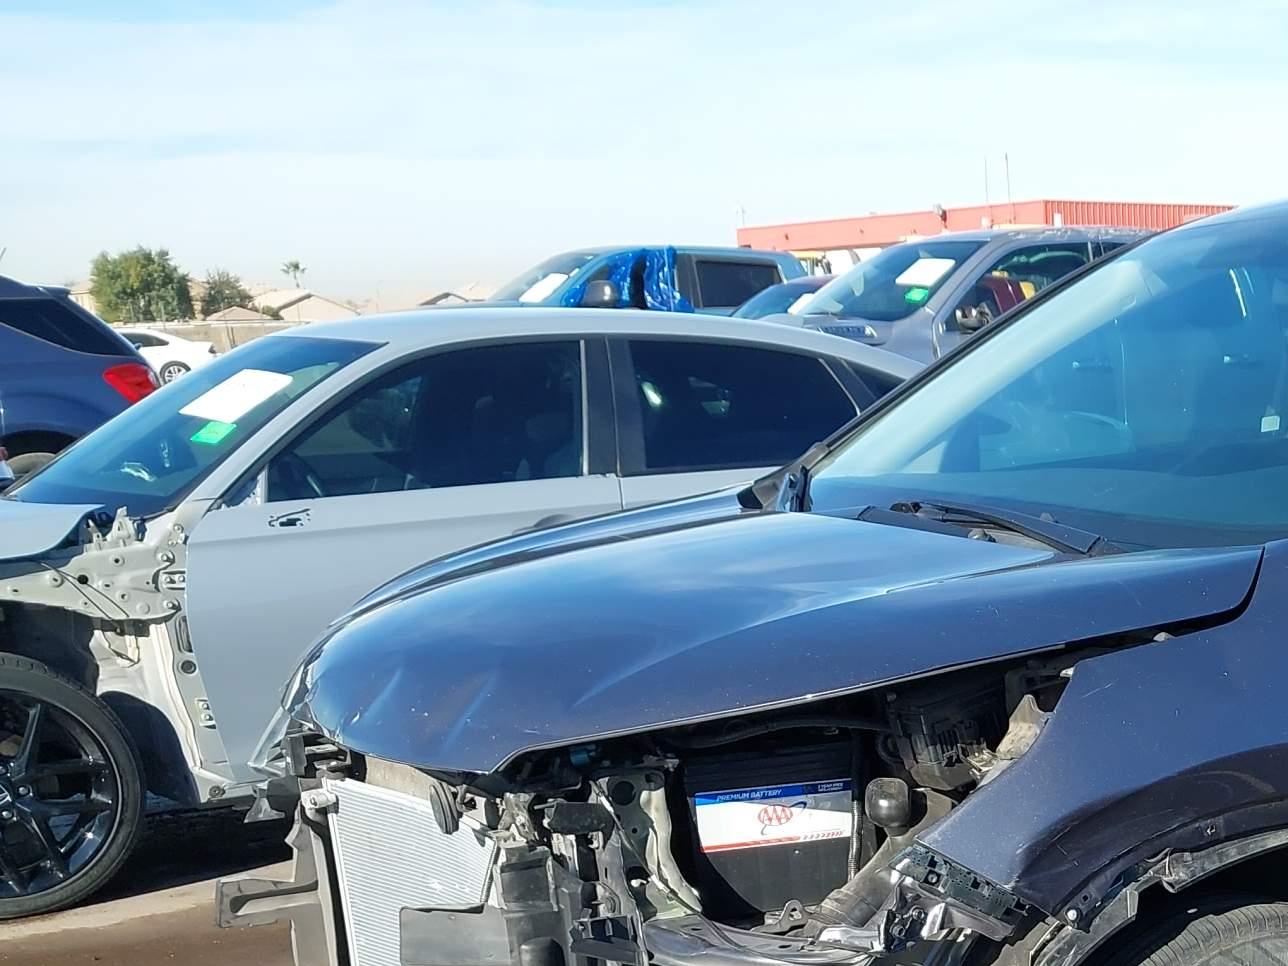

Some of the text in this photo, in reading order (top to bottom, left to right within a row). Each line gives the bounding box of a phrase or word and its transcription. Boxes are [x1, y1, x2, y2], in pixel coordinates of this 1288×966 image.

[716, 789, 782, 801] PREMIUM BATTERY
[761, 806, 790, 825] AAA
